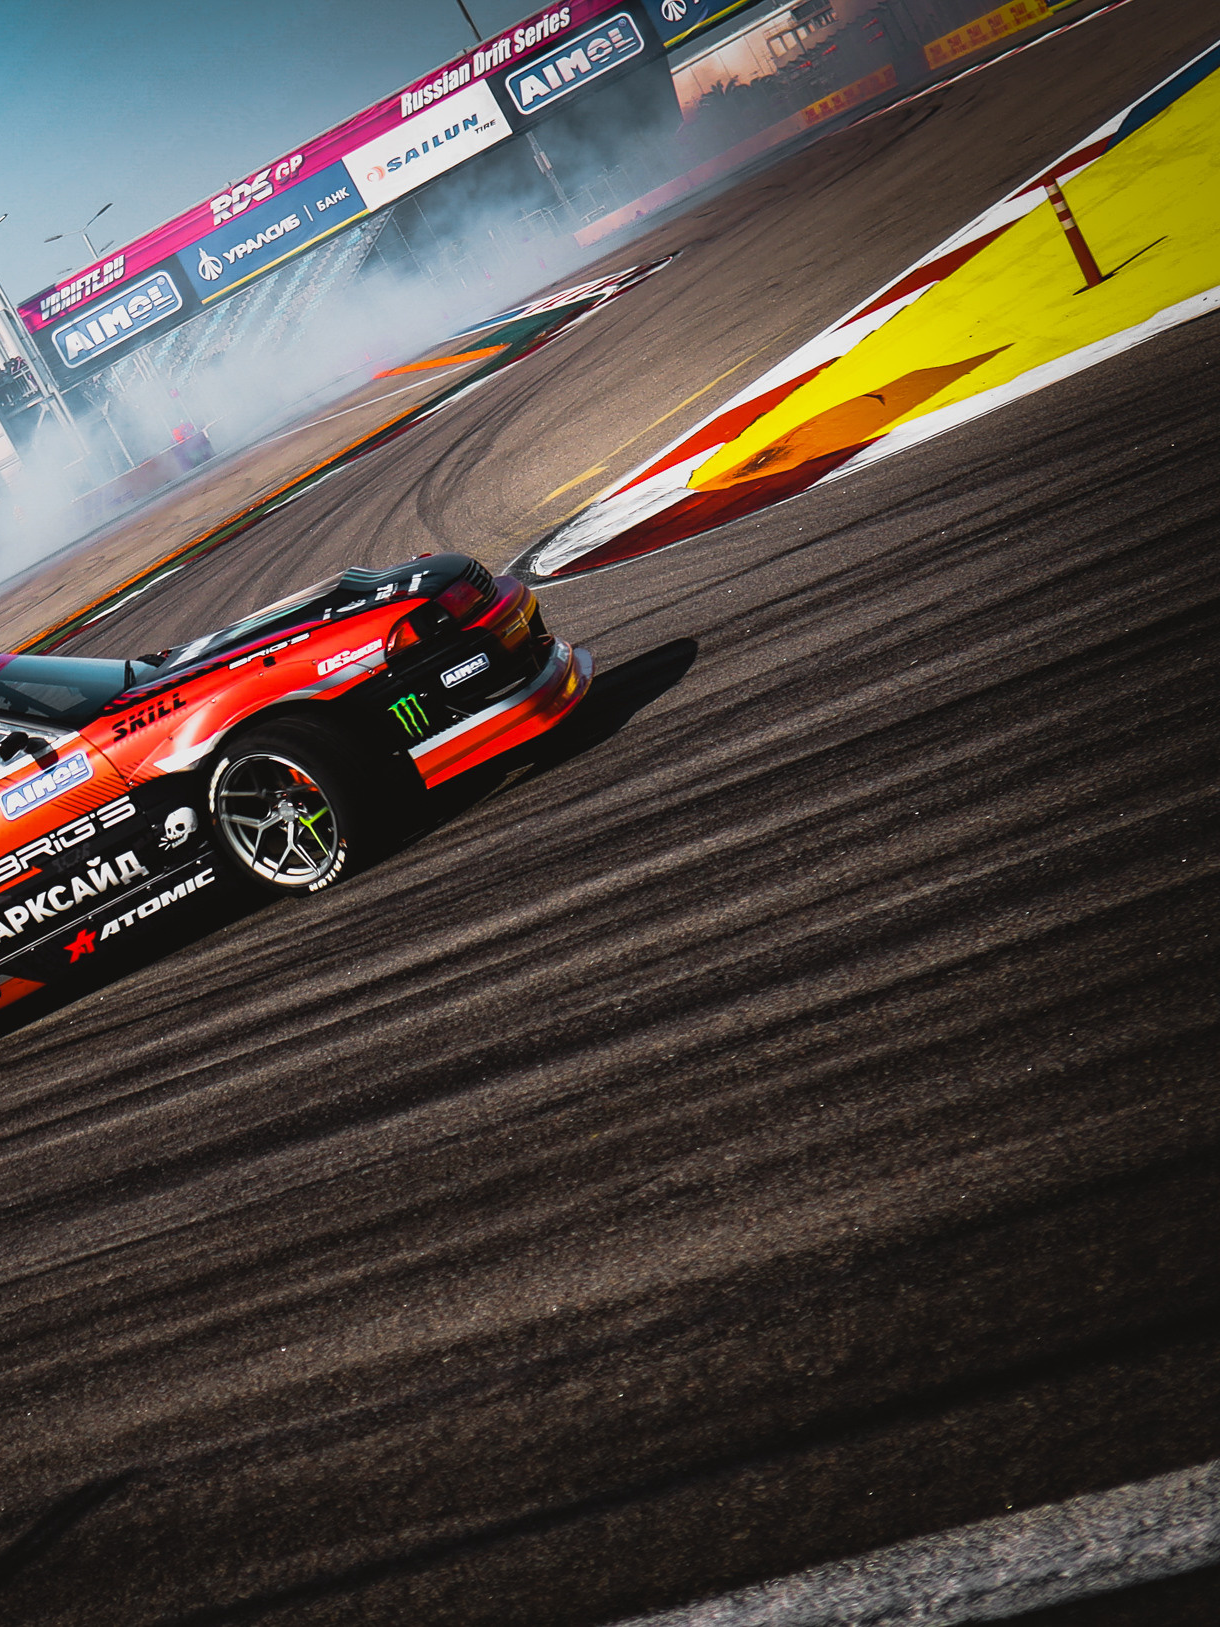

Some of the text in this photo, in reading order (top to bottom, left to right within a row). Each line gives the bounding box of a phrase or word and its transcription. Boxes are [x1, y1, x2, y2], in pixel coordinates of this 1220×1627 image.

[400, 6, 571, 119] Russian Drift Series
[519, 27, 637, 107] AIMOL
[386, 113, 479, 173] SAILUN
[474, 119, 496, 134] TIRE
[210, 154, 305, 226] RDS GP
[223, 186, 350, 264] УРАЛСИБ БАНК
[65, 285, 175, 361] AIMOL
[111, 692, 187, 742] SKILL
[6, 759, 89, 815] AIMOL
[100, 867, 216, 942] ATOMIC
